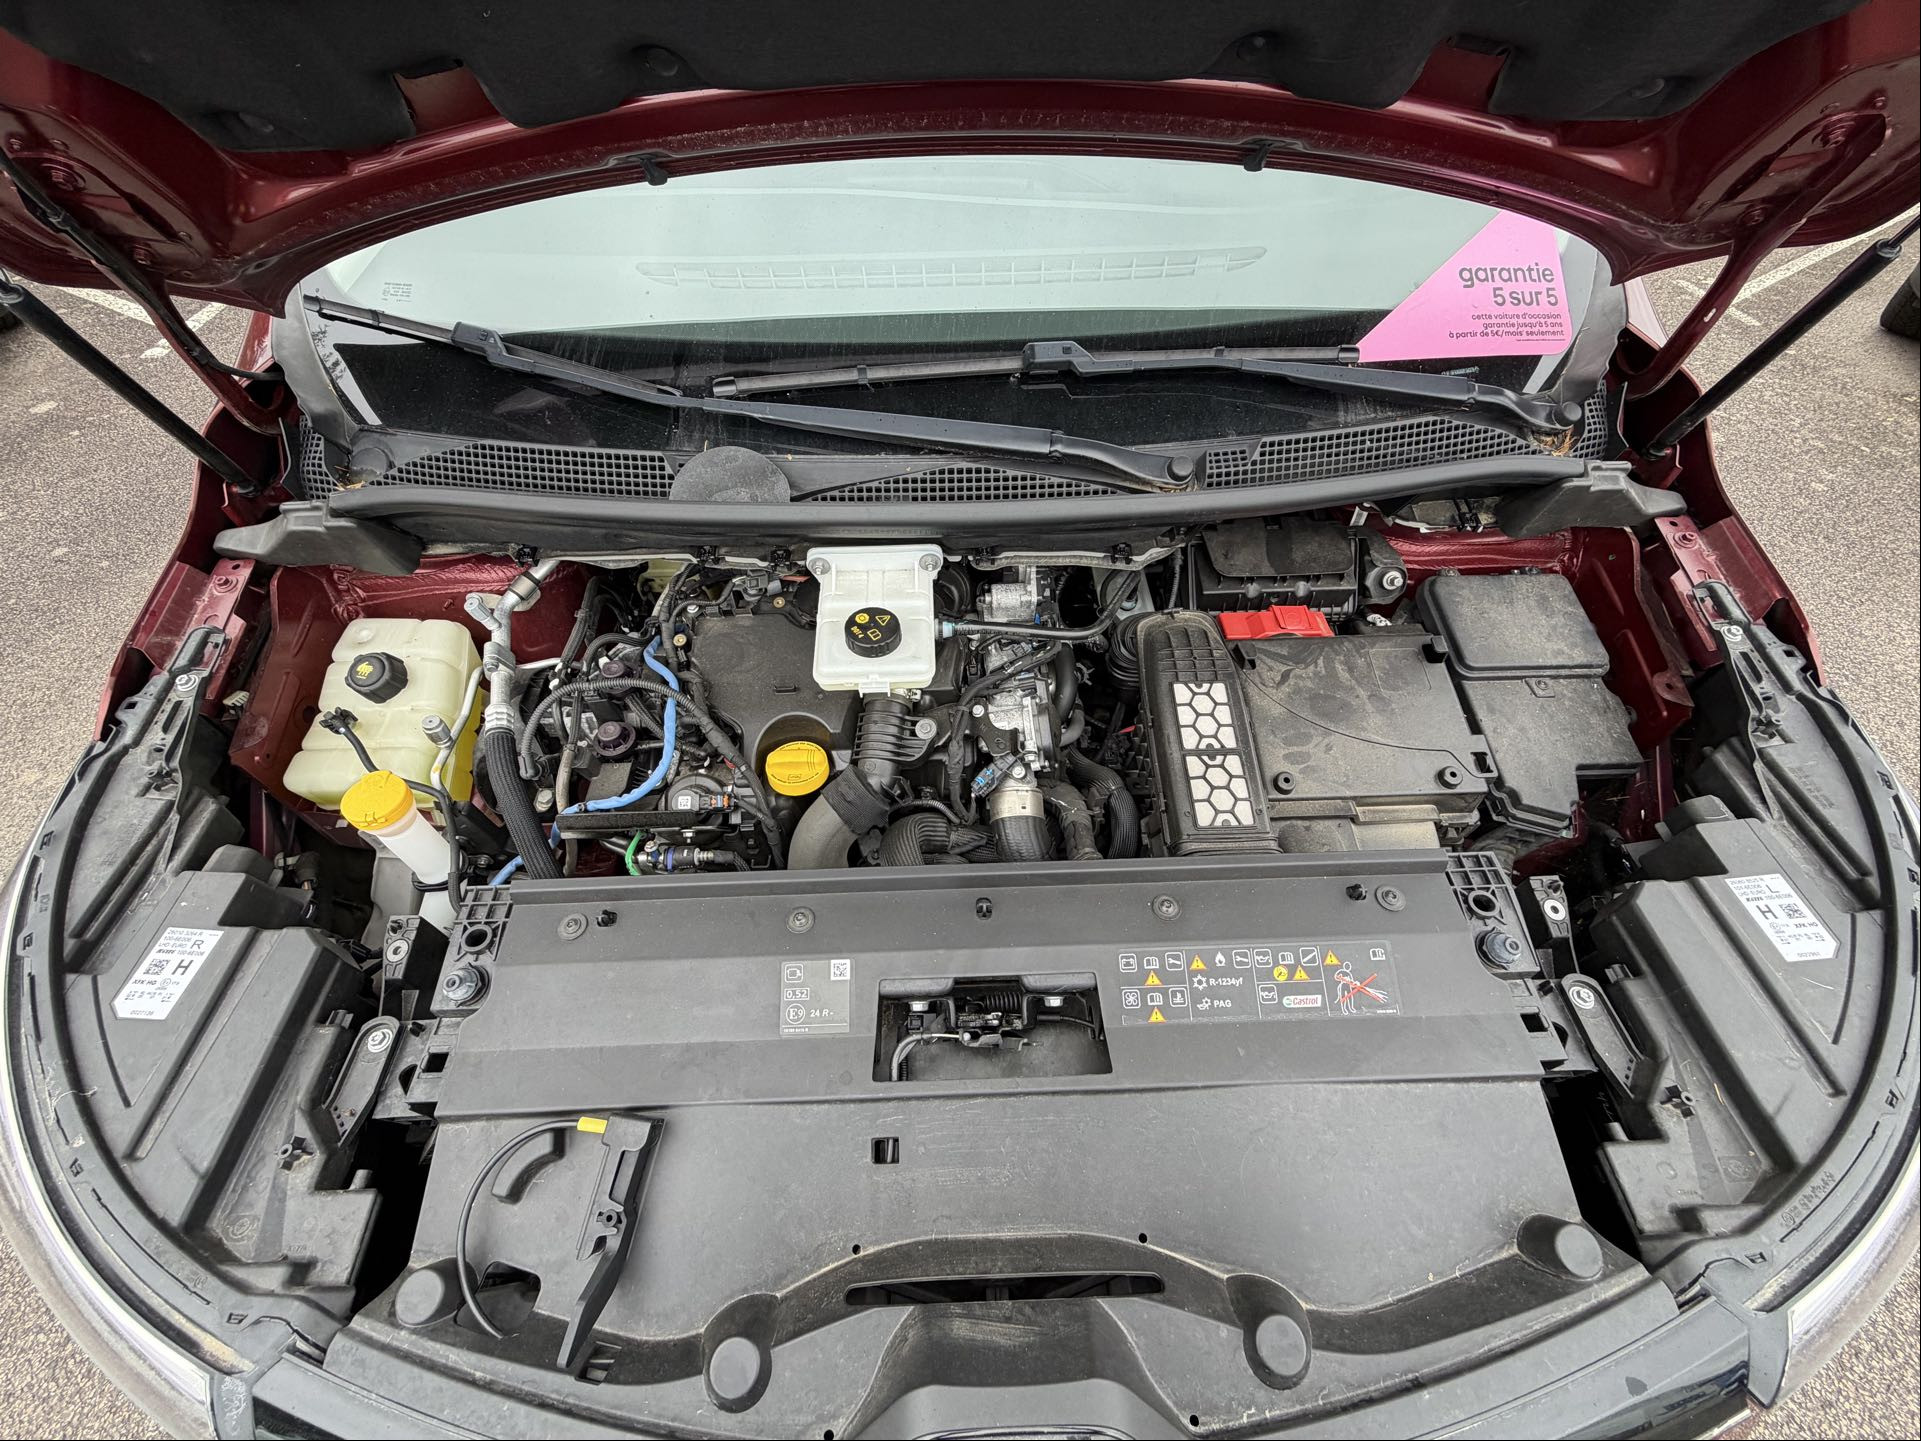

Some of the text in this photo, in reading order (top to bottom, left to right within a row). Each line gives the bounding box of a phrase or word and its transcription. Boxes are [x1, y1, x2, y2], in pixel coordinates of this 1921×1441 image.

[1459, 262, 1554, 288] garantie
[1492, 287, 1558, 306] 5 sur 5
[1494, 312, 1520, 320] voiture
[1482, 321, 1515, 330] garantie
[1455, 330, 1478, 339] partir
[1525, 329, 1564, 337] seulement
[1765, 884, 1780, 893] L
[1756, 904, 1778, 920] H
[190, 939, 204, 949] R
[171, 959, 194, 976] H
[1209, 977, 1243, 987] R-1234yf
[786, 990, 807, 999] 0,52
[1214, 999, 1232, 1008] PAG
[1292, 996, 1319, 1006] Castrol
[810, 1009, 820, 1017] 24
